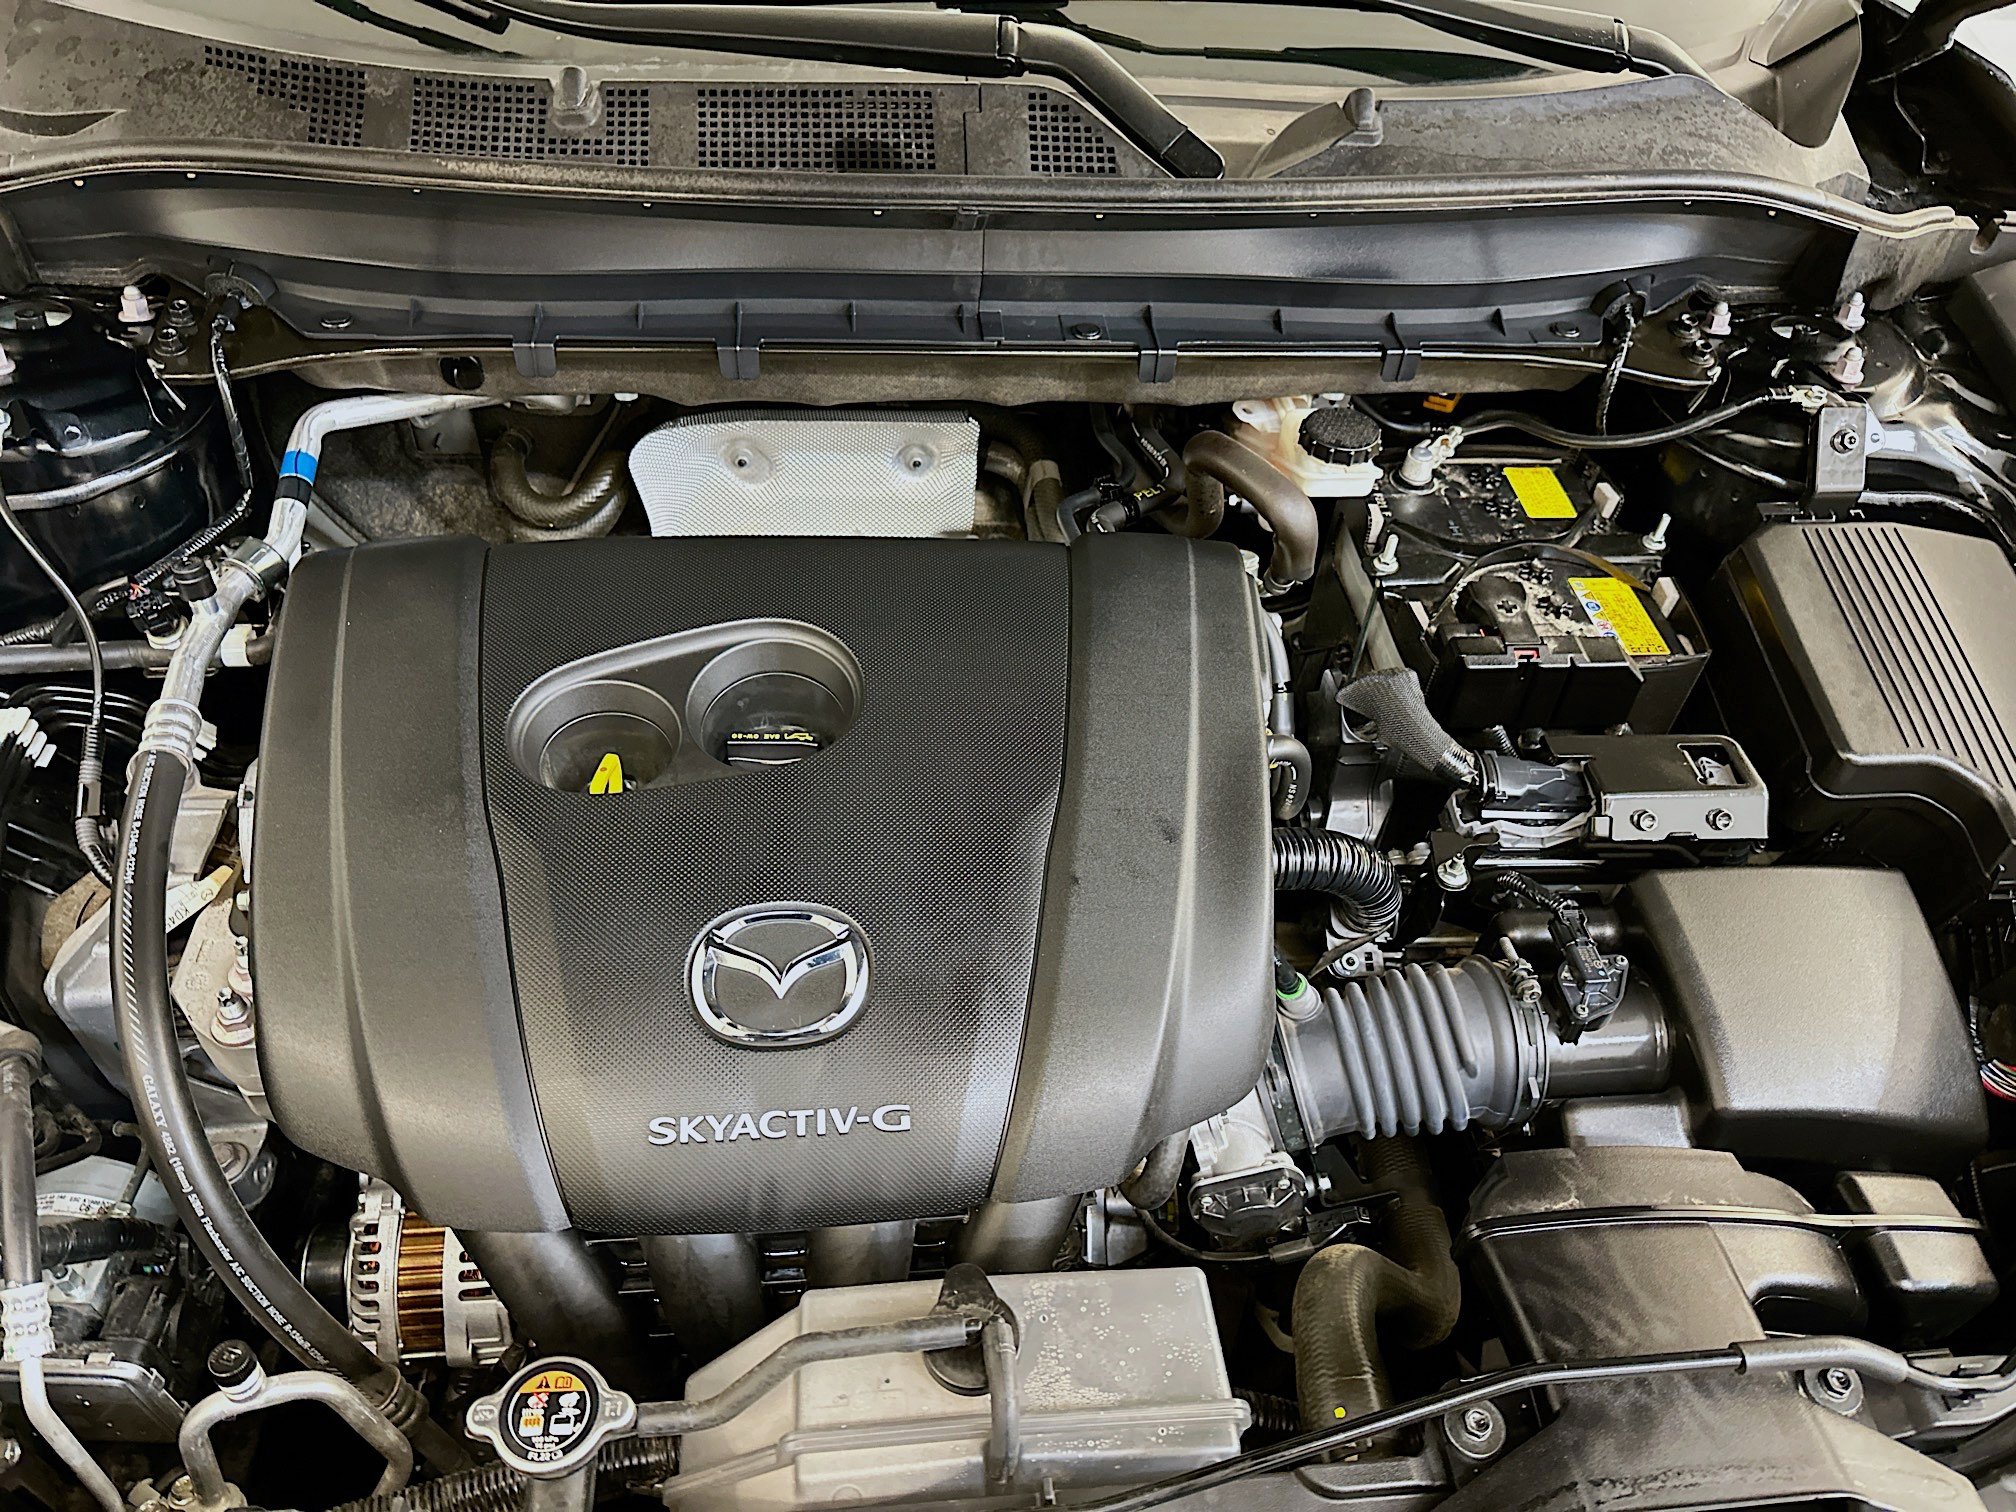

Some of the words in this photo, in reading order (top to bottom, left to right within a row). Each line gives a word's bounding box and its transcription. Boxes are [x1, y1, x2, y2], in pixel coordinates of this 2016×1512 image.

[138, 766, 154, 798] SUCTION
[133, 798, 146, 820] HOSE
[648, 1104, 911, 1145] SKYACTIV-G
[142, 1074, 168, 1128] GALAXY
[240, 1275, 271, 1308] SUCTION
[266, 1305, 287, 1326] HOSE
